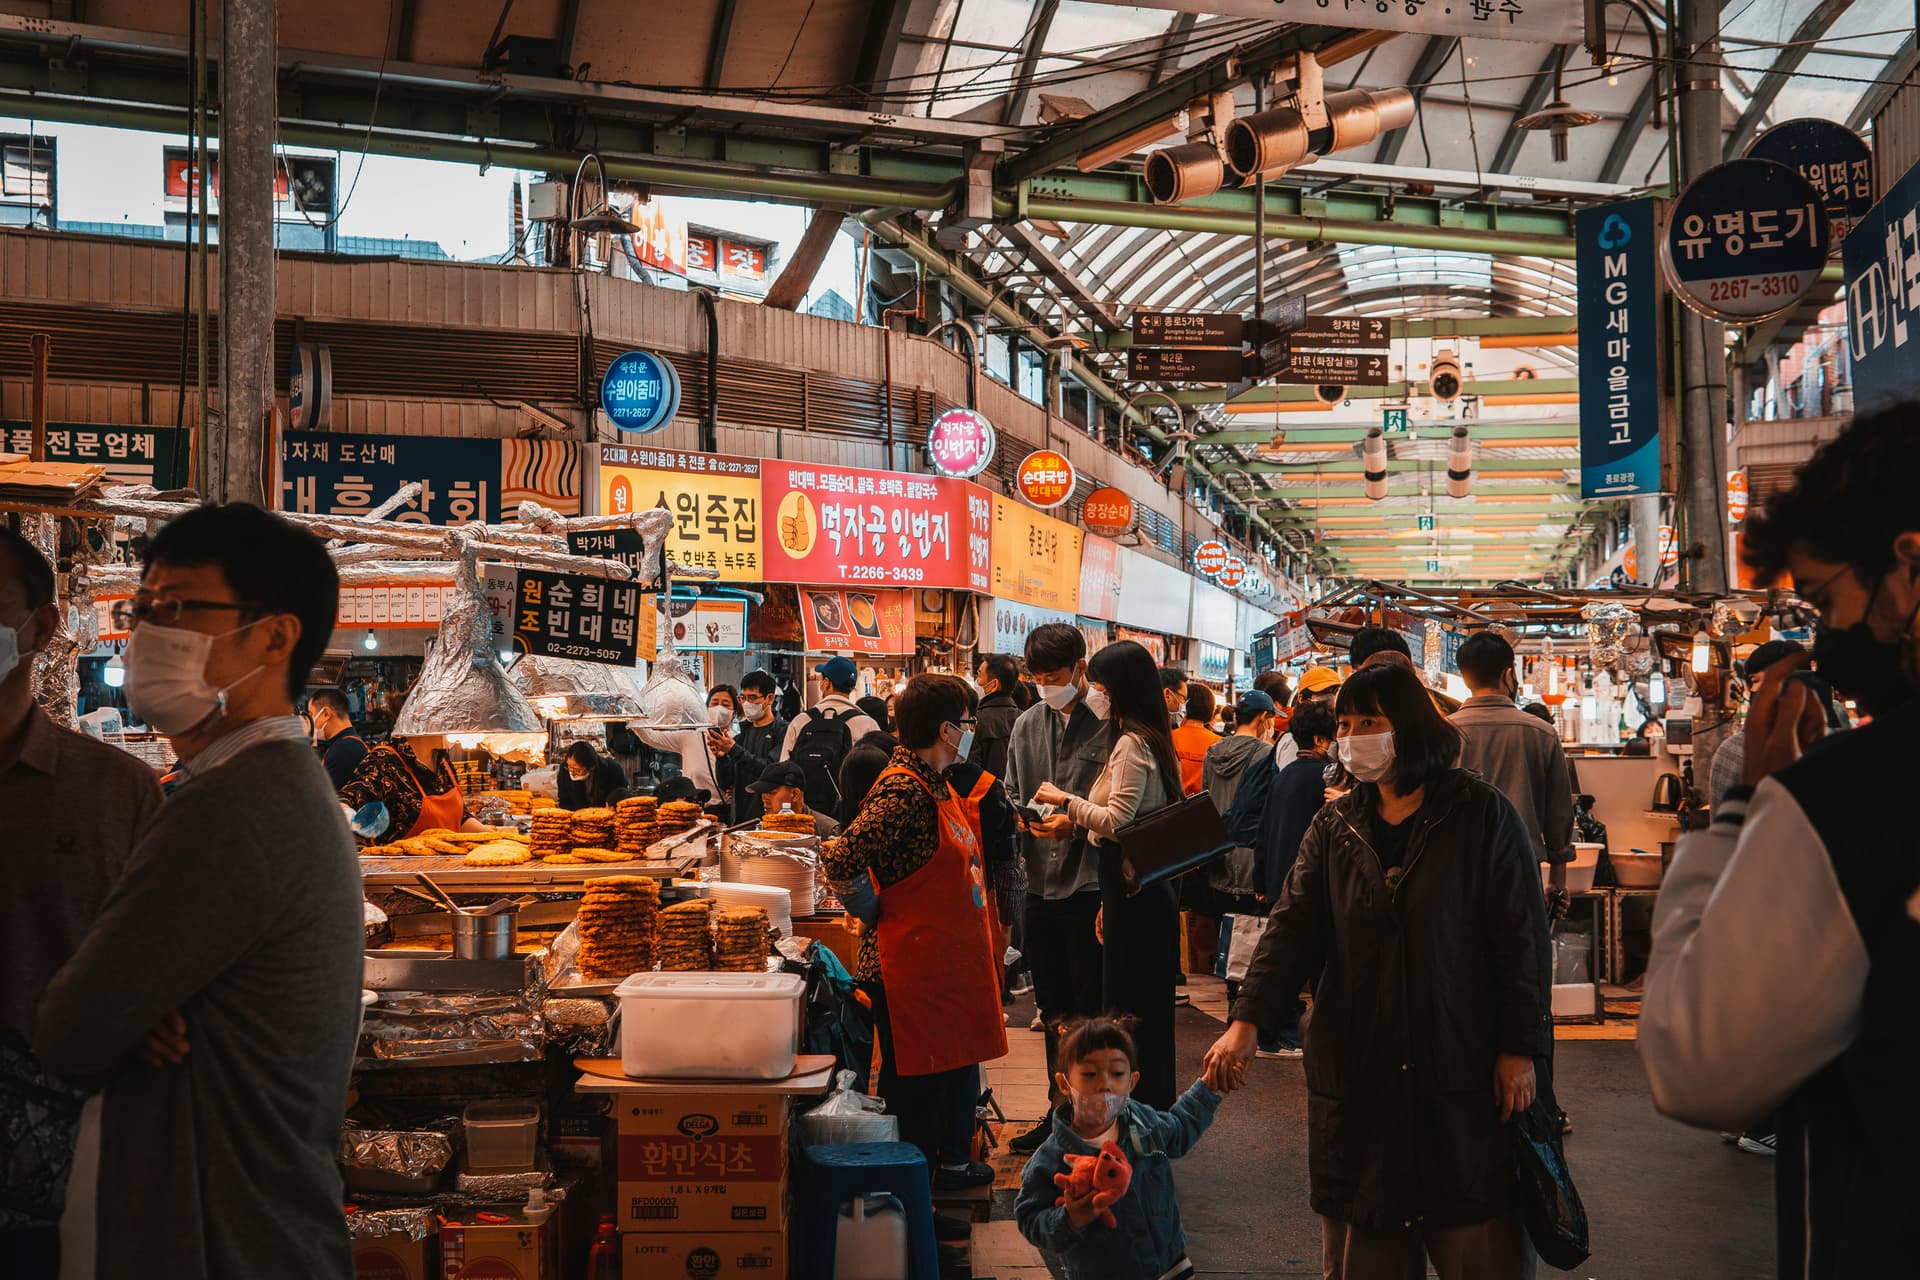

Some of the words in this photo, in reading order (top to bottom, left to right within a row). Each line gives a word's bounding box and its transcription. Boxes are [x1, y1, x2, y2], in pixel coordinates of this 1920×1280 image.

[1800, 159, 1870, 201] 원떡집
[1678, 203, 1817, 260] 유명도기
[1710, 274, 1800, 301] 2267-3310
[1164, 316, 1205, 327] 종로5가역
[1332, 320, 1360, 330] 청계천
[1160, 353, 1183, 363] 북2문
[1603, 252, 1632, 445] MG새마을금고
[605, 379, 661, 401] 수원아줌마
[941, 421, 975, 436] 먹자골
[46, 430, 155, 459] 전문업체
[339, 444, 396, 464] 도산매
[934, 438, 980, 460] 일번지
[603, 447, 628, 464] 2대째
[631, 450, 675, 468] 수원아줌마
[678, 454, 687, 469] 죽
[689, 456, 706, 471] 전문
[1030, 457, 1060, 469] 육회
[1022, 470, 1068, 485] 순대국밥
[1605, 472, 1635, 484] 종로광장
[1028, 485, 1062, 497] 빈대떡
[1087, 503, 1130, 520] 광장순대
[821, 502, 887, 557] 먹자골
[891, 507, 951, 561] 일번지
[577, 535, 615, 551] 박가네
[1029, 524, 1058, 564] 종로식당
[838, 564, 924, 581] T.2266-3439
[488, 578, 515, 592] 동부A
[548, 579, 637, 617] 순희네
[492, 621, 505, 635] 호
[547, 610, 634, 647] 빈대떡
[547, 642, 622, 661] 02-2273-5057
[641, 1142, 757, 1177] 환만식초
